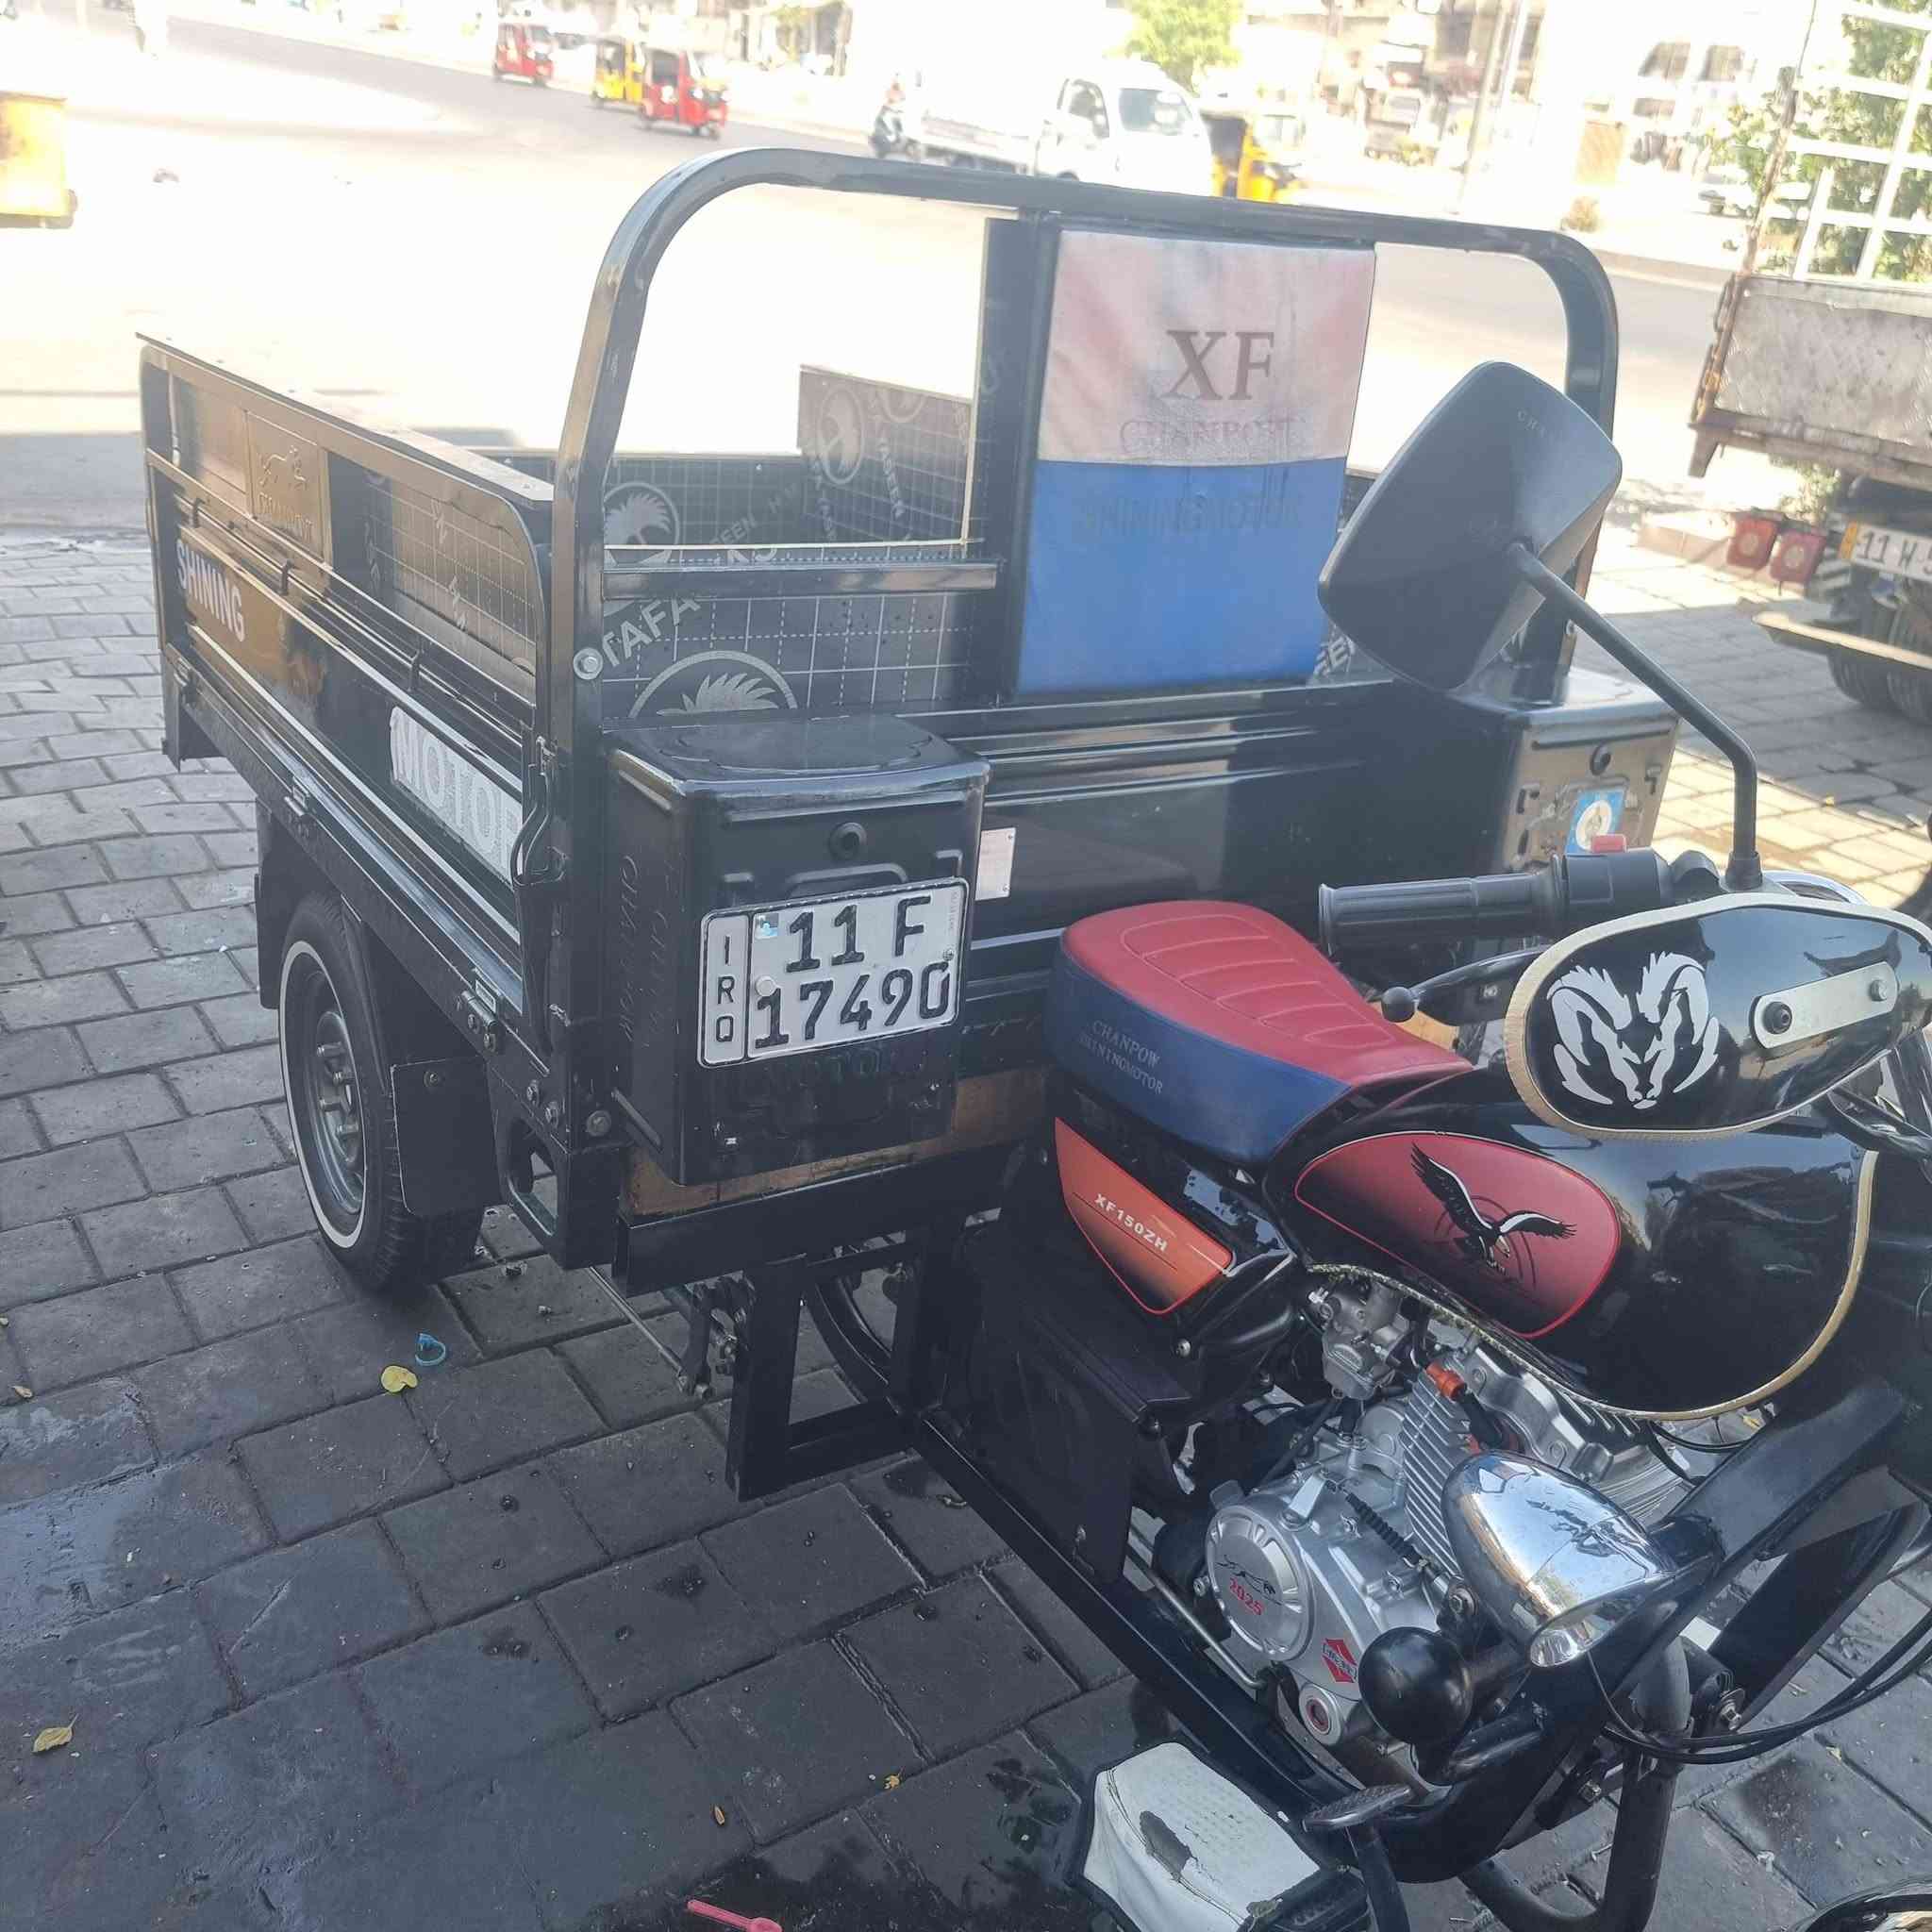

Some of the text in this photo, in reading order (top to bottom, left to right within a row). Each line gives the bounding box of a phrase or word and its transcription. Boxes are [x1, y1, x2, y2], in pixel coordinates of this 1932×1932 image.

[1160, 329, 1274, 401] XF
[175, 538, 245, 642] SHINING
[785, 905, 866, 973] 11
[895, 894, 932, 957] F
[755, 961, 952, 1049] 17490
[1094, 1192, 1169, 1253] XF150ZH
[1229, 1572, 1266, 1617] 2025
